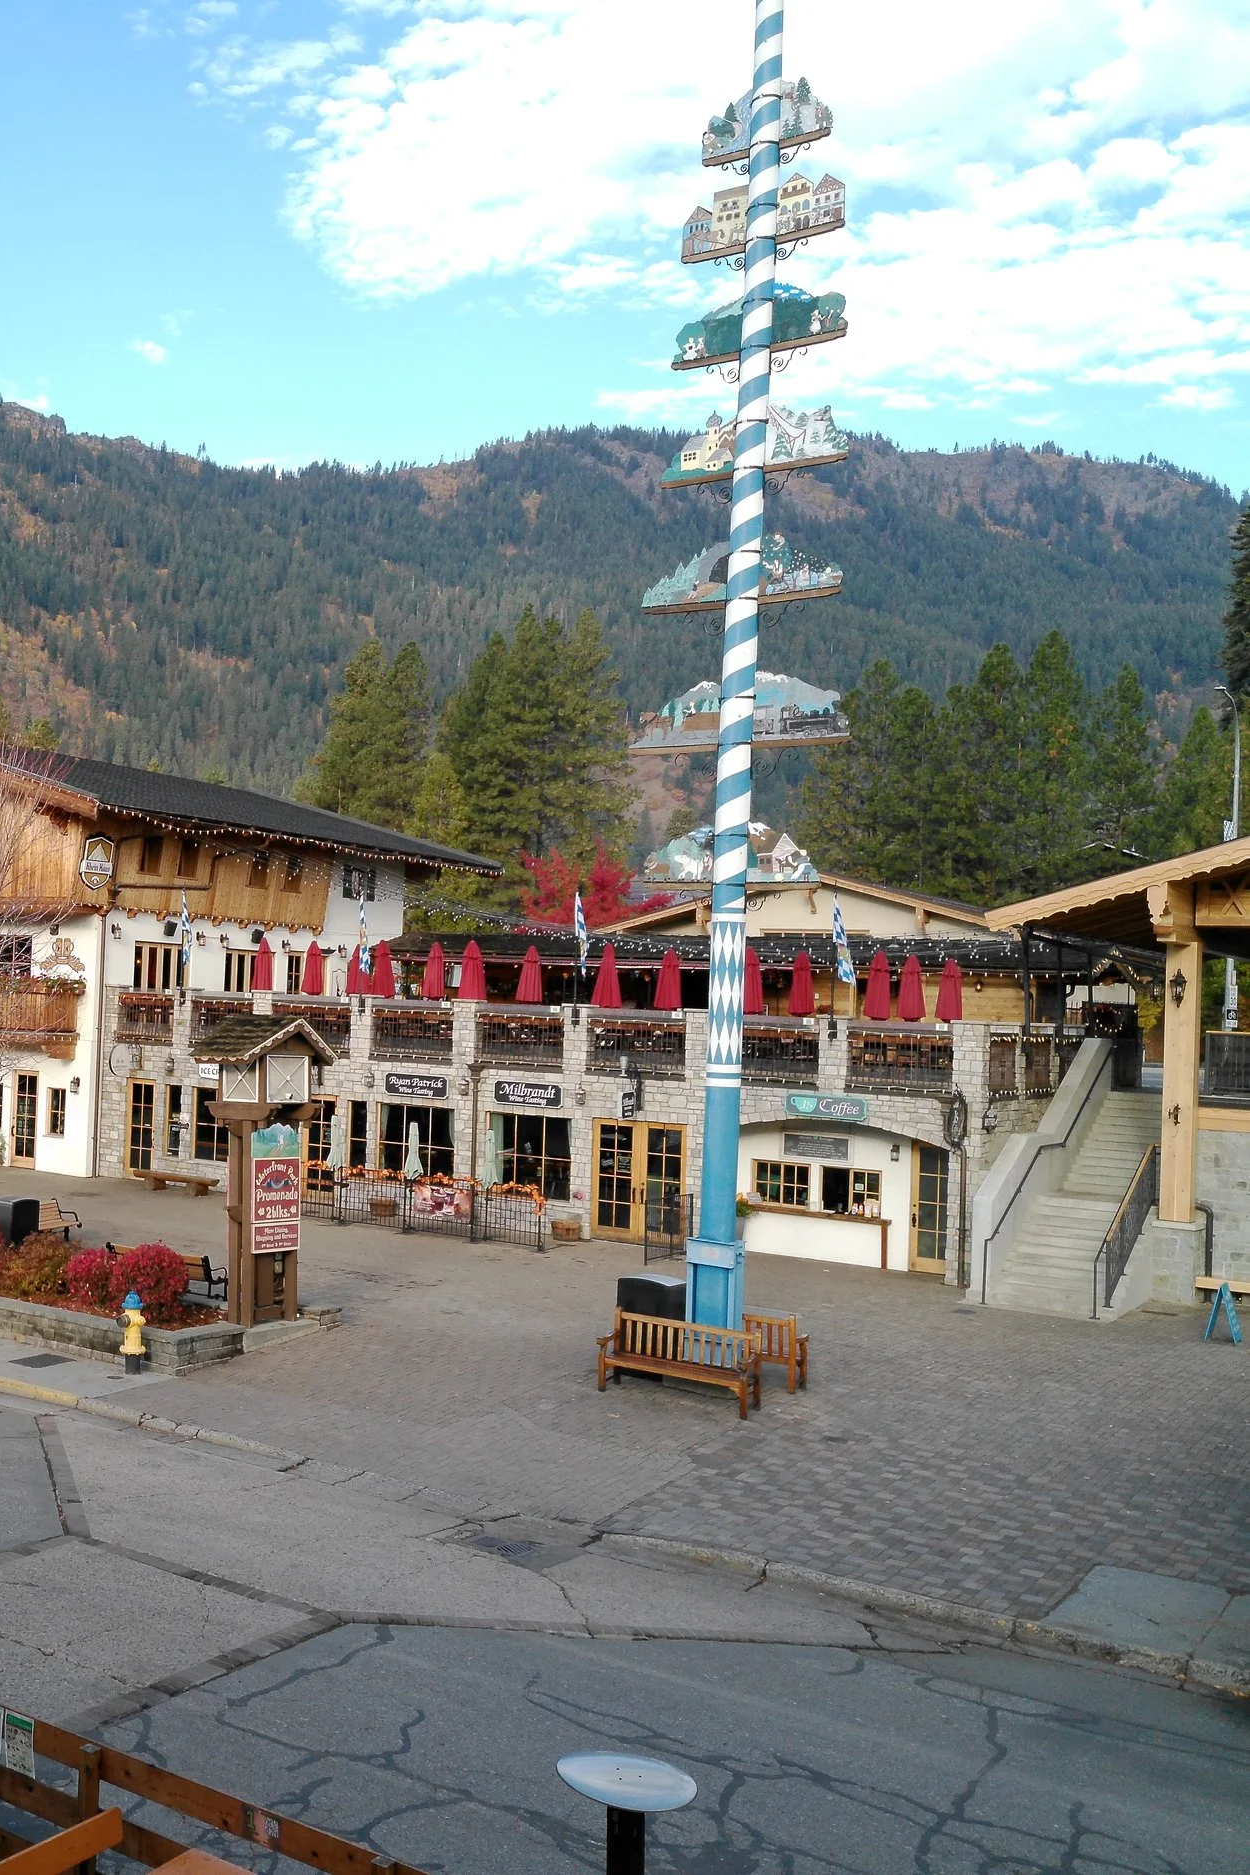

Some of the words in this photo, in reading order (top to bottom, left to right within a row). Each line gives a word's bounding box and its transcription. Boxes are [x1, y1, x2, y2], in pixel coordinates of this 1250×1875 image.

[200, 1067, 211, 1075] ICE
[389, 1076, 410, 1088] Ryan
[411, 1078, 443, 1088] Patrick
[499, 1083, 556, 1098] Milbrandt
[819, 1098, 859, 1116] Coffee
[256, 1161, 287, 1185] Waterfront
[288, 1165, 298, 1185] Park
[256, 1187, 298, 1202] Promenade
